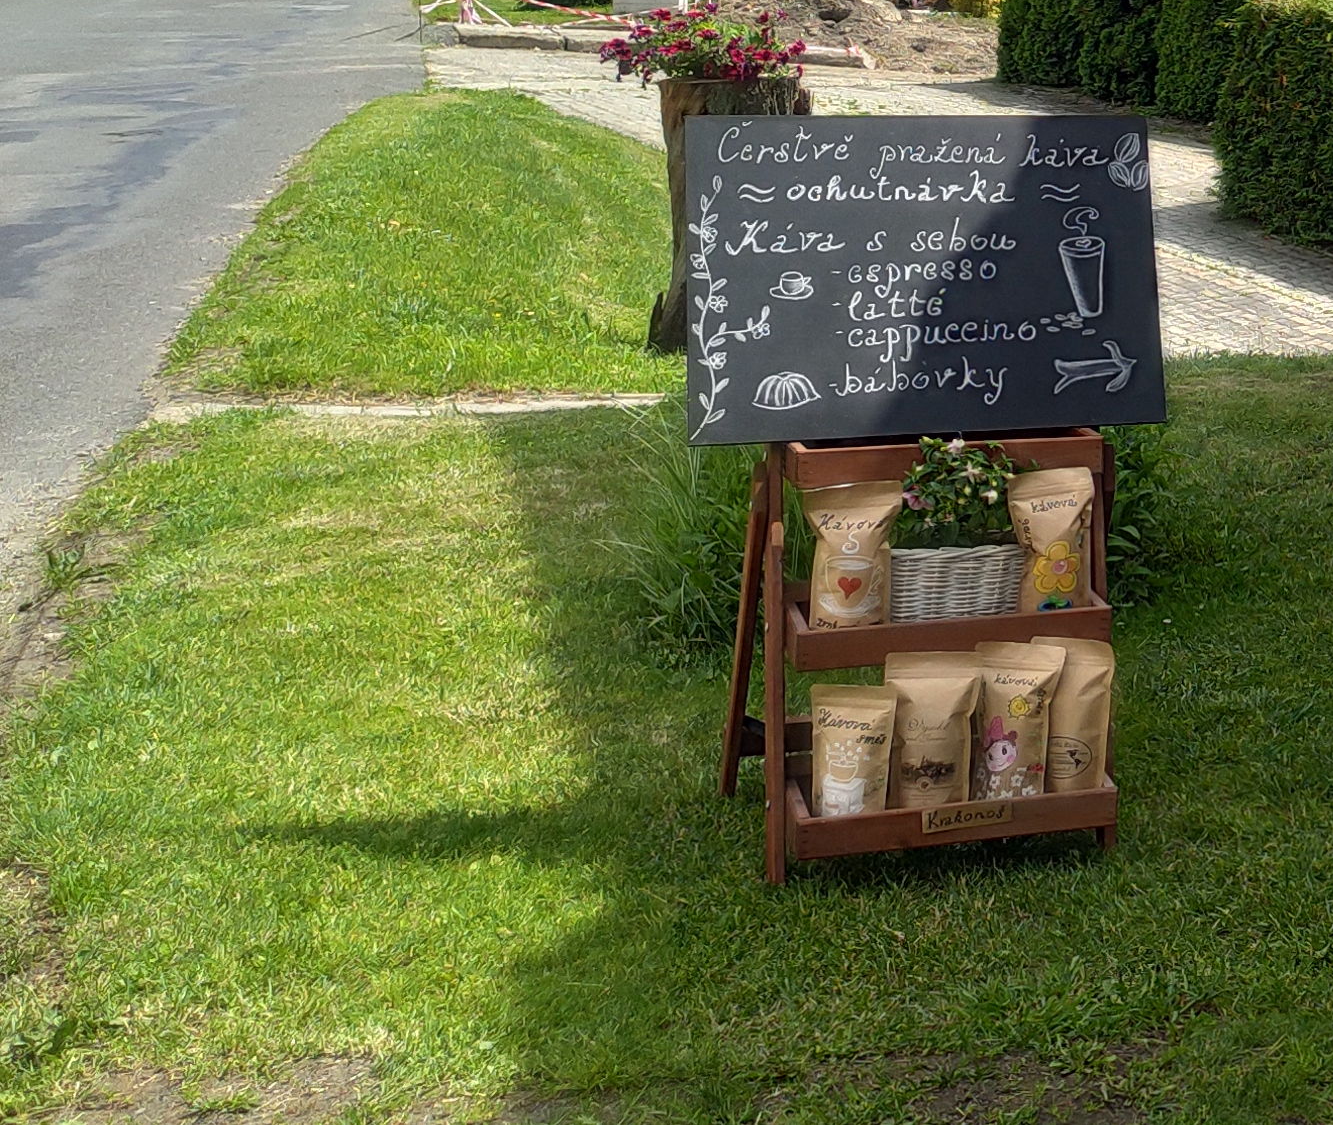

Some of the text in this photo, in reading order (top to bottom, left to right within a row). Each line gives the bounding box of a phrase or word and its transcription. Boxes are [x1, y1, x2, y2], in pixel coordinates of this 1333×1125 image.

[718, 120, 1110, 179] Čerstvě pražená káva
[786, 170, 1016, 204] ochutnávka
[725, 216, 1017, 256] Káva s sebou
